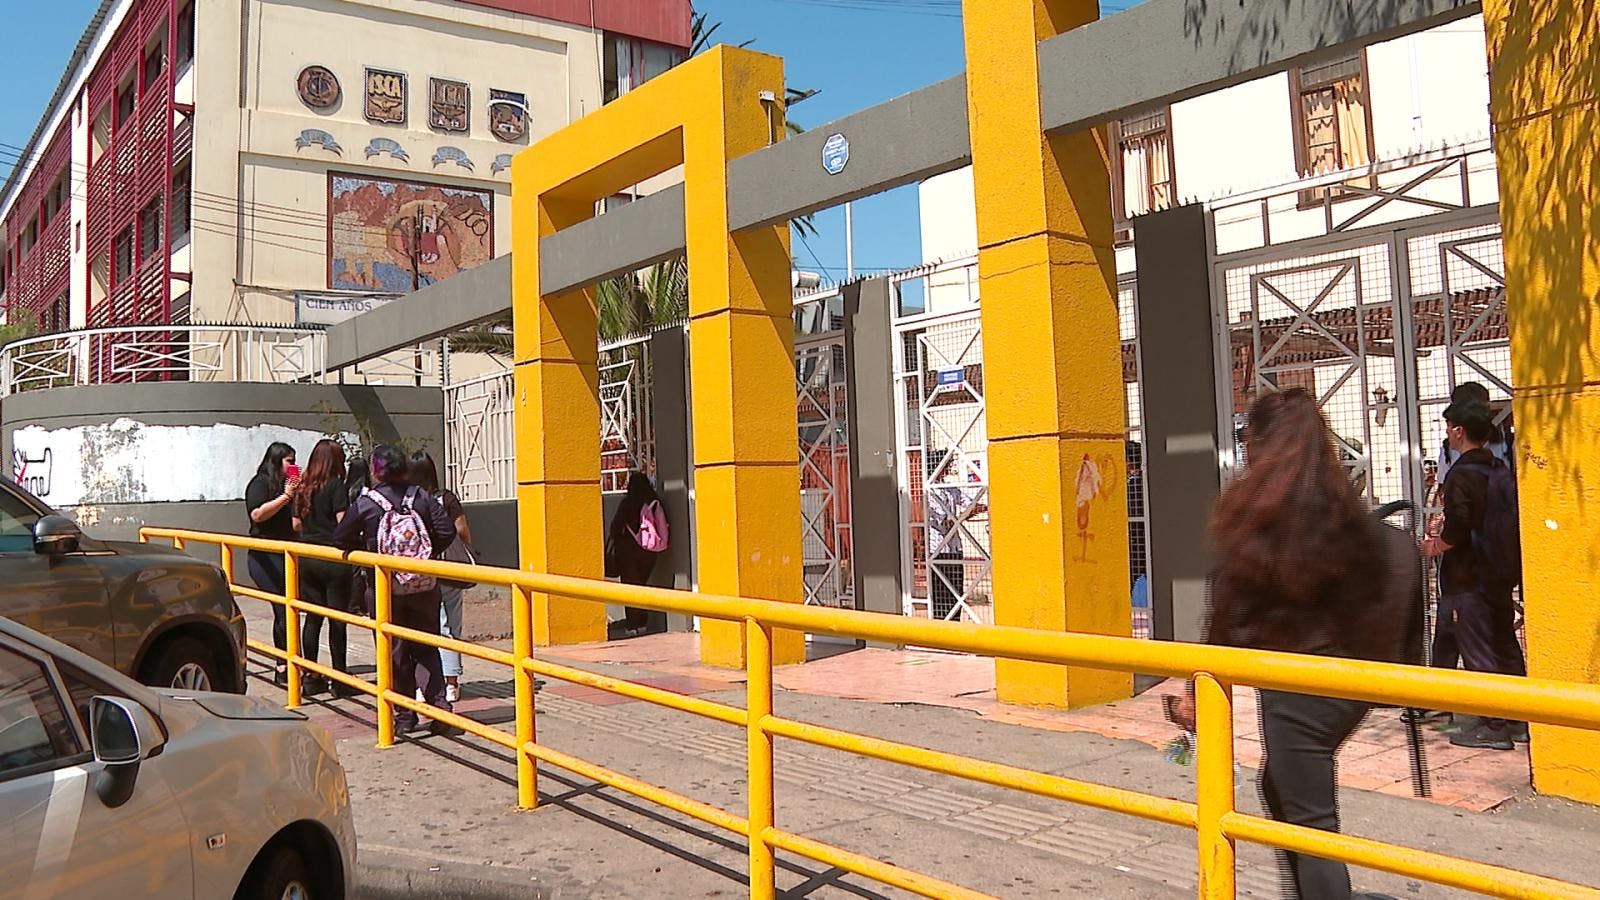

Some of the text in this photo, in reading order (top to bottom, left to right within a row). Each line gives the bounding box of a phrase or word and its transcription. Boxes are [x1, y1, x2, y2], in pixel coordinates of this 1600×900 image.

[368, 74, 401, 98] ISCA
[306, 299, 373, 312] CIEN AÑOS
